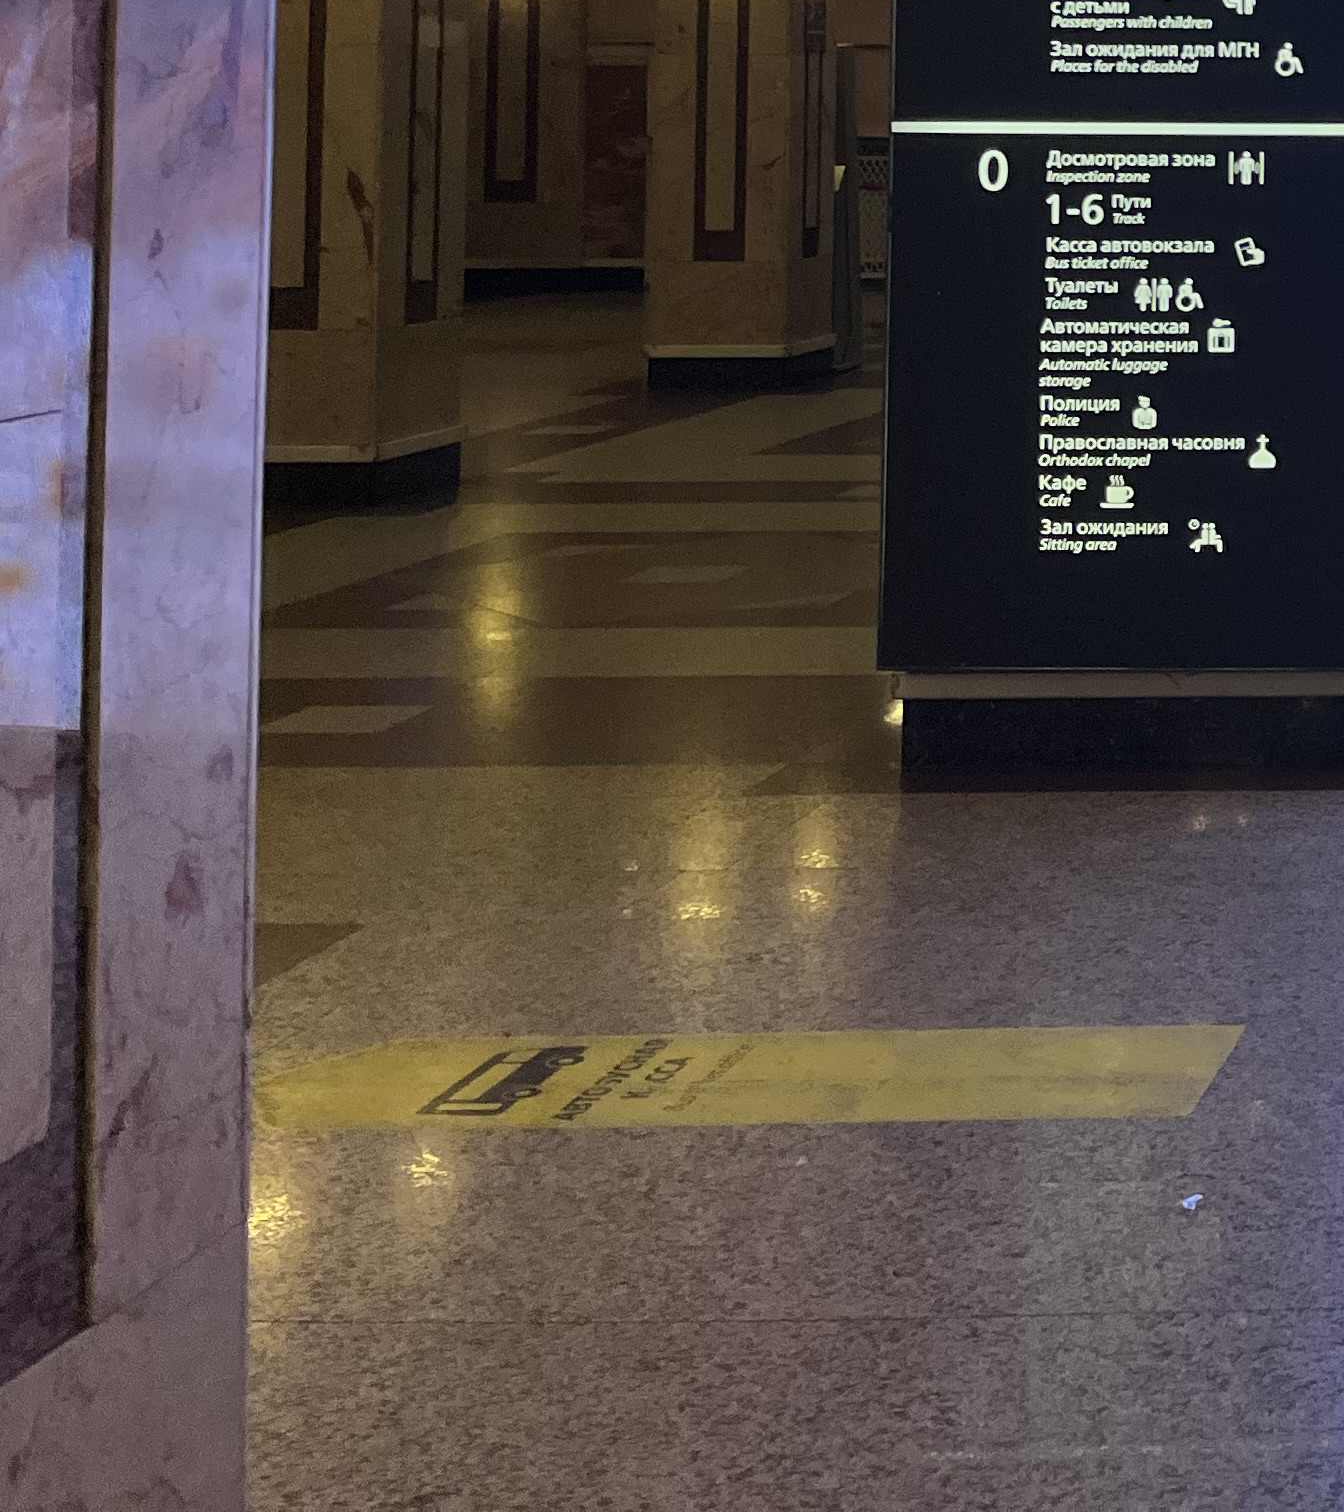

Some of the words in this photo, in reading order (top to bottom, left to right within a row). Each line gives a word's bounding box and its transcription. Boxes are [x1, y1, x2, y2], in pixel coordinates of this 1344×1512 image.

[1050, 3, 1060, 14] с
[1062, 1, 1130, 16] детьми
[1050, 15, 1125, 31] Passengers
[1126, 16, 1157, 29] with
[1158, 16, 1213, 30] children
[1050, 41, 1083, 57] Зал
[1085, 42, 1179, 60] ожидания
[1180, 44, 1215, 59] для
[1217, 42, 1260, 58] МГН
[1050, 59, 1092, 73] Places
[1093, 59, 1113, 73] for
[1115, 60, 1139, 73] the
[1140, 60, 1200, 74] disabled
[1046, 150, 1169, 170] Досмотровая
[1171, 154, 1216, 167] зона
[978, 149, 1009, 192] 0
[1046, 170, 1115, 185] Inspection
[1116, 172, 1151, 183] zone
[1045, 193, 1104, 225] 1-6
[1111, 194, 1152, 212] Пути
[1113, 212, 1146, 225] Track
[1046, 237, 1098, 254] Касса
[1100, 239, 1215, 254] автовокзала
[1045, 256, 1070, 269] Bus
[1071, 257, 1108, 270] ticket
[1109, 256, 1149, 270] office
[1045, 277, 1119, 297] Туалеты
[1045, 296, 1088, 310] Toilets
[1040, 317, 1190, 336] Автоматическая
[1040, 339, 1107, 356] камера
[1111, 339, 1199, 356] хранения
[1038, 358, 1110, 372] Automatic
[1111, 358, 1169, 374] luggage
[1038, 375, 1091, 390] storage
[1039, 394, 1121, 414] Полиция
[1039, 414, 1080, 427] Police
[1038, 434, 1169, 454] Православная
[1171, 436, 1246, 450] часовня
[1037, 453, 1103, 467] Orthodox
[1105, 453, 1151, 469] chapel
[1038, 474, 1087, 495] Кафе
[1038, 493, 1071, 507] Cafe
[1040, 519, 1073, 536] Зал
[1076, 521, 1169, 537] ожидания
[1038, 538, 1084, 554] Sitting
[1085, 539, 1117, 551] area
[619, 1056, 697, 1100] КССА
